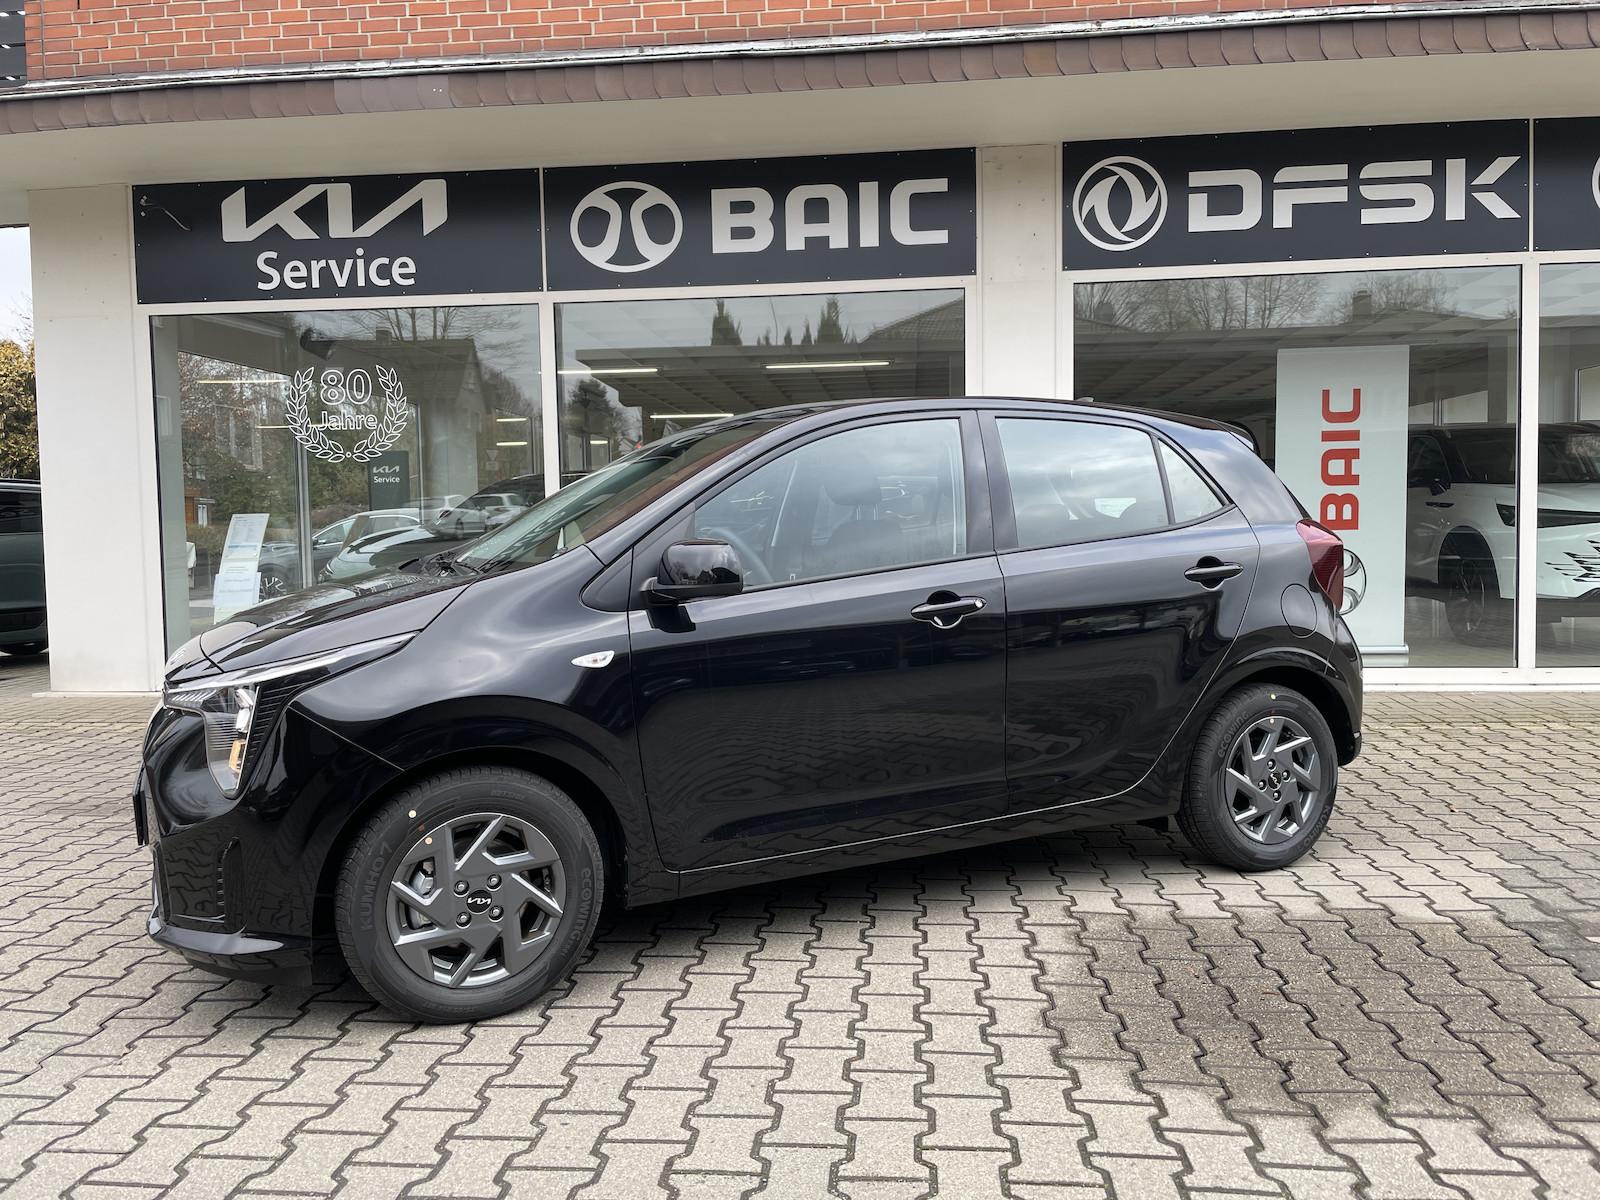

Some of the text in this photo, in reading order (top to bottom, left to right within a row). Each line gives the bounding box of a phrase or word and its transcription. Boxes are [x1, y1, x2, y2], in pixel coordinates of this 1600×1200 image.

[221, 178, 448, 242] KIA
[711, 177, 949, 254] BAIC
[1188, 155, 1521, 233] DFSK
[256, 247, 417, 291] Service
[320, 368, 372, 405] 80
[318, 410, 378, 431] Jahre
[372, 465, 400, 473] KIA
[373, 475, 400, 483] Service
[1320, 387, 1361, 530] BAIC
[360, 856, 385, 931] KUMHO
